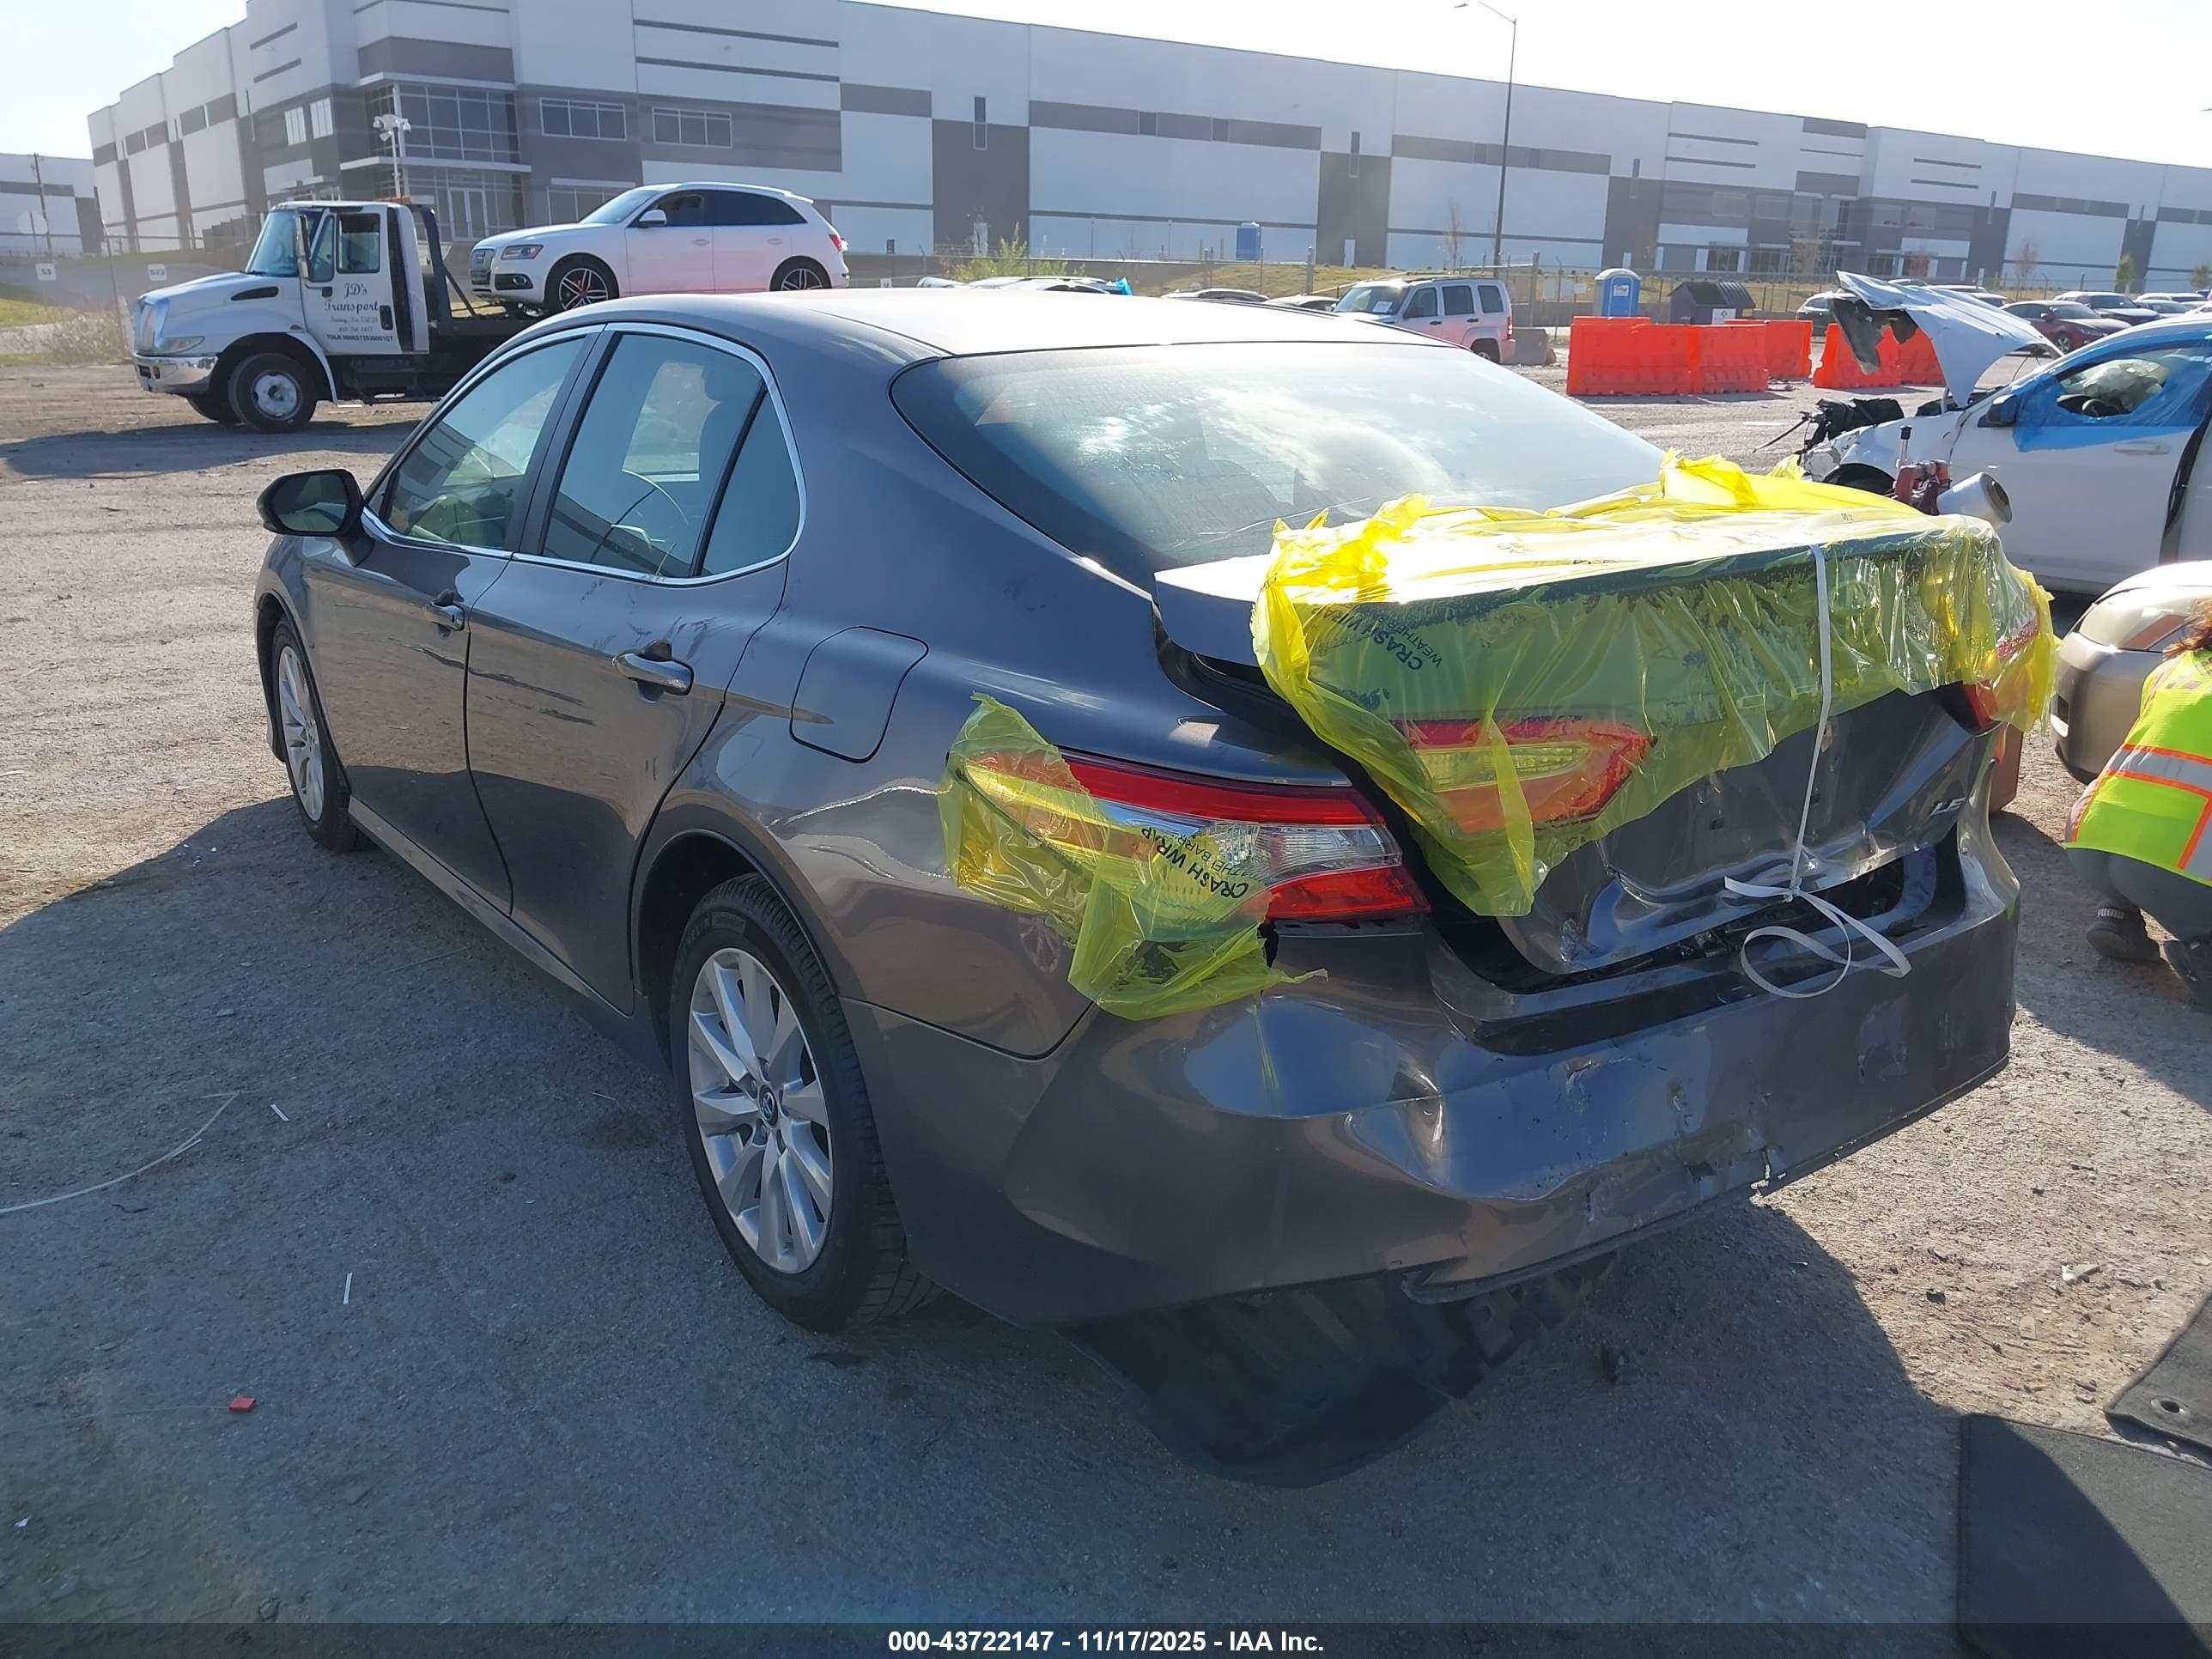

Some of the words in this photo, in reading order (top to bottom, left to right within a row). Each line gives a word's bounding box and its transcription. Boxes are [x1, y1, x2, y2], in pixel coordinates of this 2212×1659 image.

[324, 299, 379, 314] Transport
[1929, 796, 1967, 817] LE
[1187, 861, 1249, 899] CRASH
